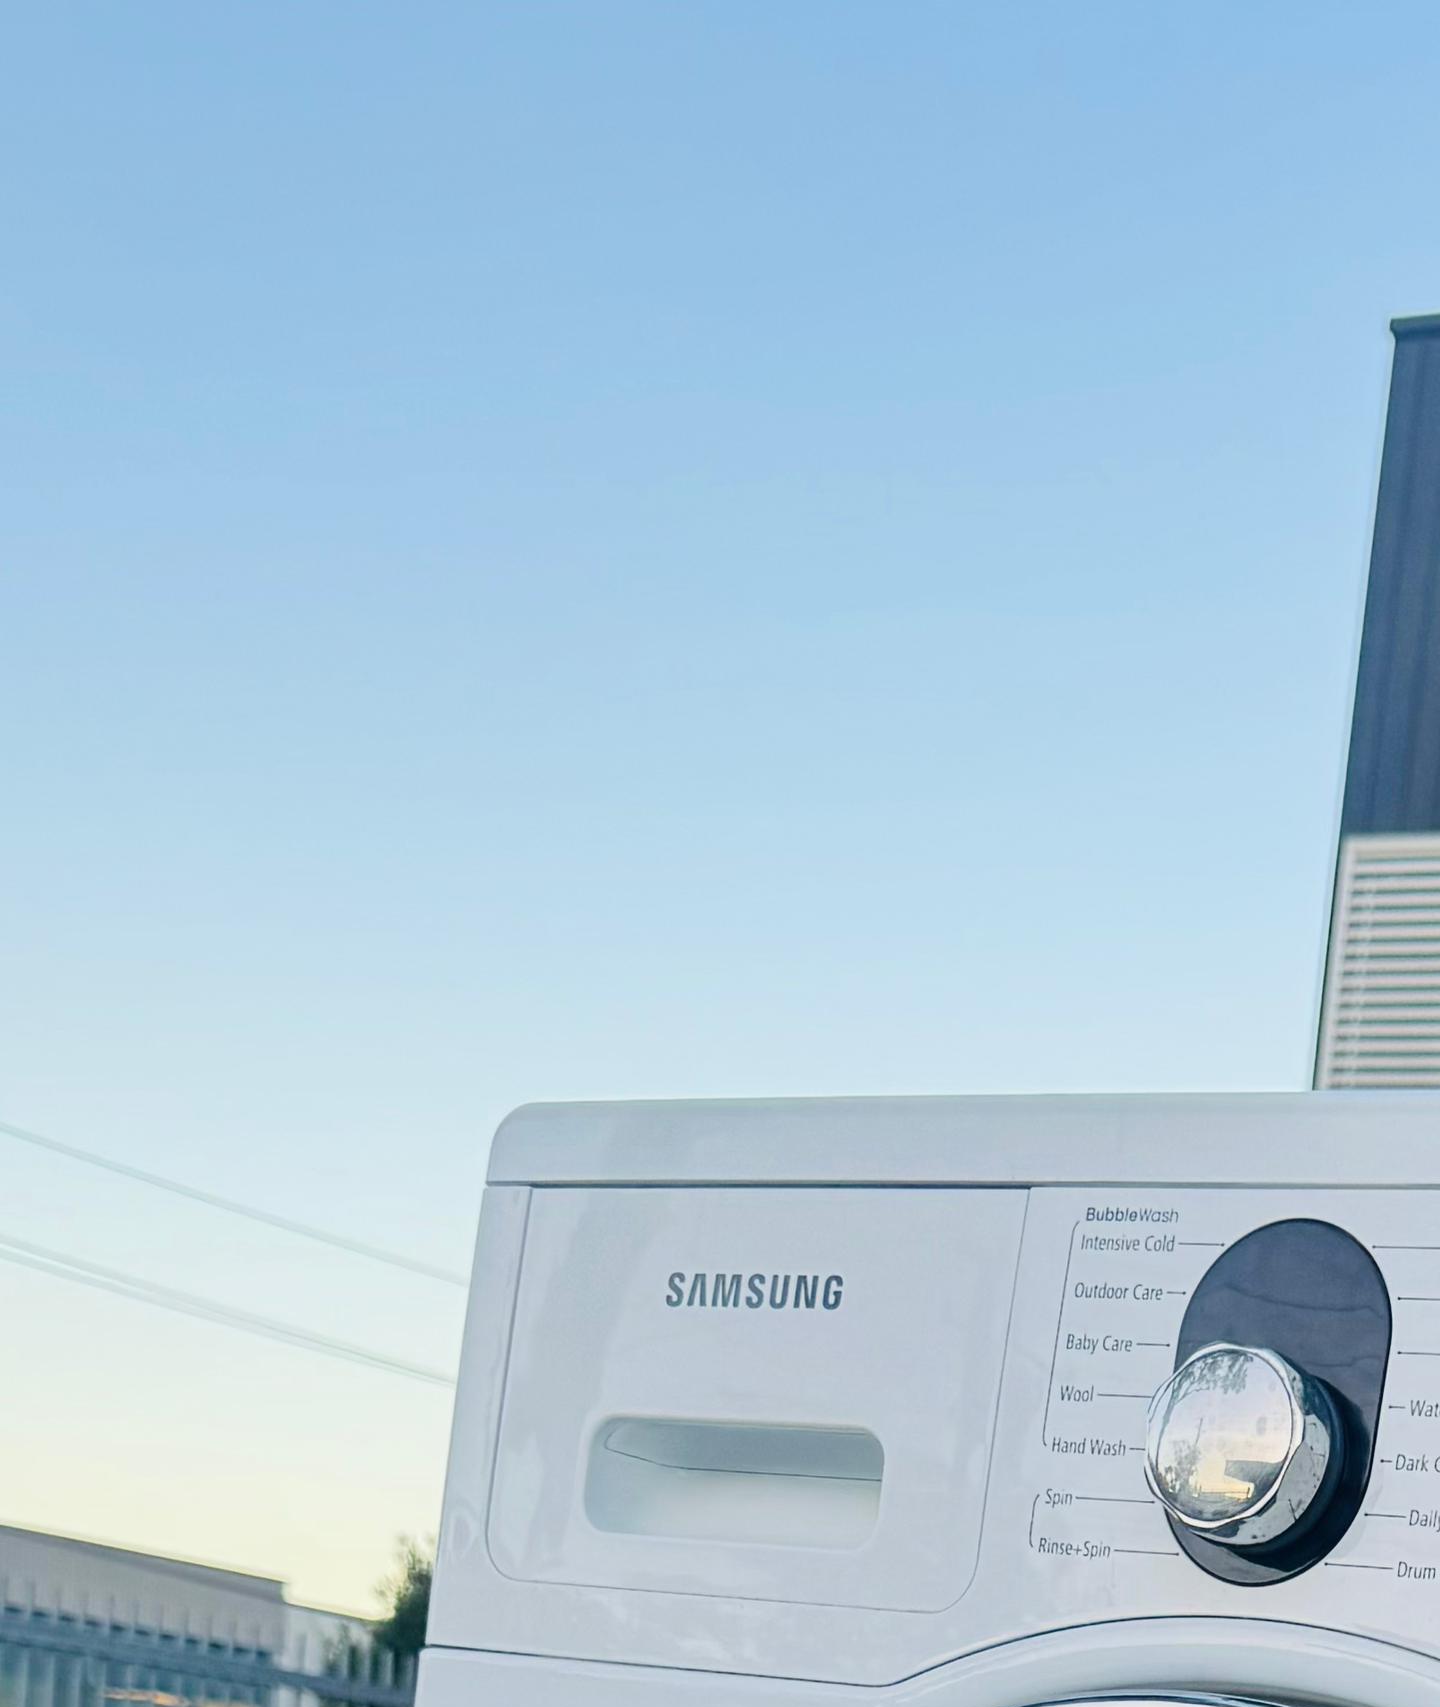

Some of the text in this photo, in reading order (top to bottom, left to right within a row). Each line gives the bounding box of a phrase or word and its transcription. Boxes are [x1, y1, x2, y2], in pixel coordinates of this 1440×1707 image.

[1085, 1207, 1179, 1224] BubbleWash
[1081, 1234, 1176, 1252] Intensive Cold
[665, 1272, 844, 1310] SAMSUNG
[1074, 1282, 1163, 1301] Outdoor Care
[1066, 1334, 1133, 1355] Baby Care
[1060, 1385, 1095, 1402] Wool
[1051, 1436, 1126, 1456] Hand Wash
[1395, 1453, 1429, 1472] Dark
[1045, 1488, 1073, 1508] Spin
[1038, 1537, 1111, 1560] Rinse+Spin
[1397, 1561, 1436, 1580] Drum
